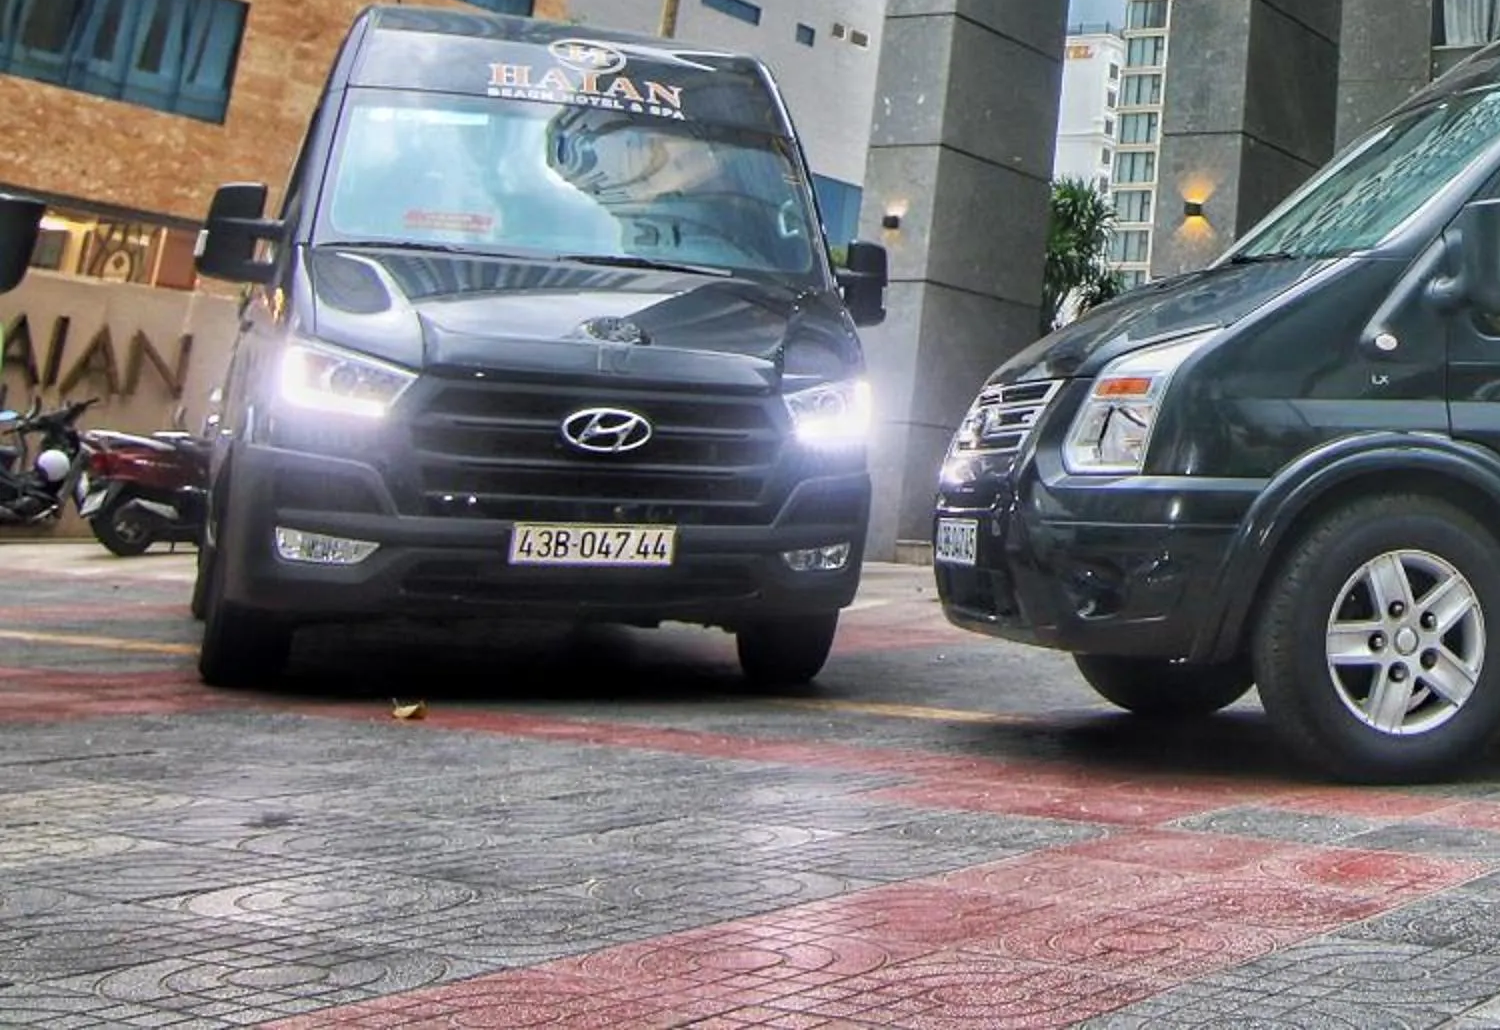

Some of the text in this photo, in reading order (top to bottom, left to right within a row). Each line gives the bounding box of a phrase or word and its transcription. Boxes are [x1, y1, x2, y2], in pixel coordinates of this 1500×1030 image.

[488, 63, 684, 109] HAIAN
[487, 87, 553, 102] BEACH
[563, 93, 625, 110] HOTEL
[649, 106, 685, 121] SPA
[518, 529, 668, 560] 43B-047.44
